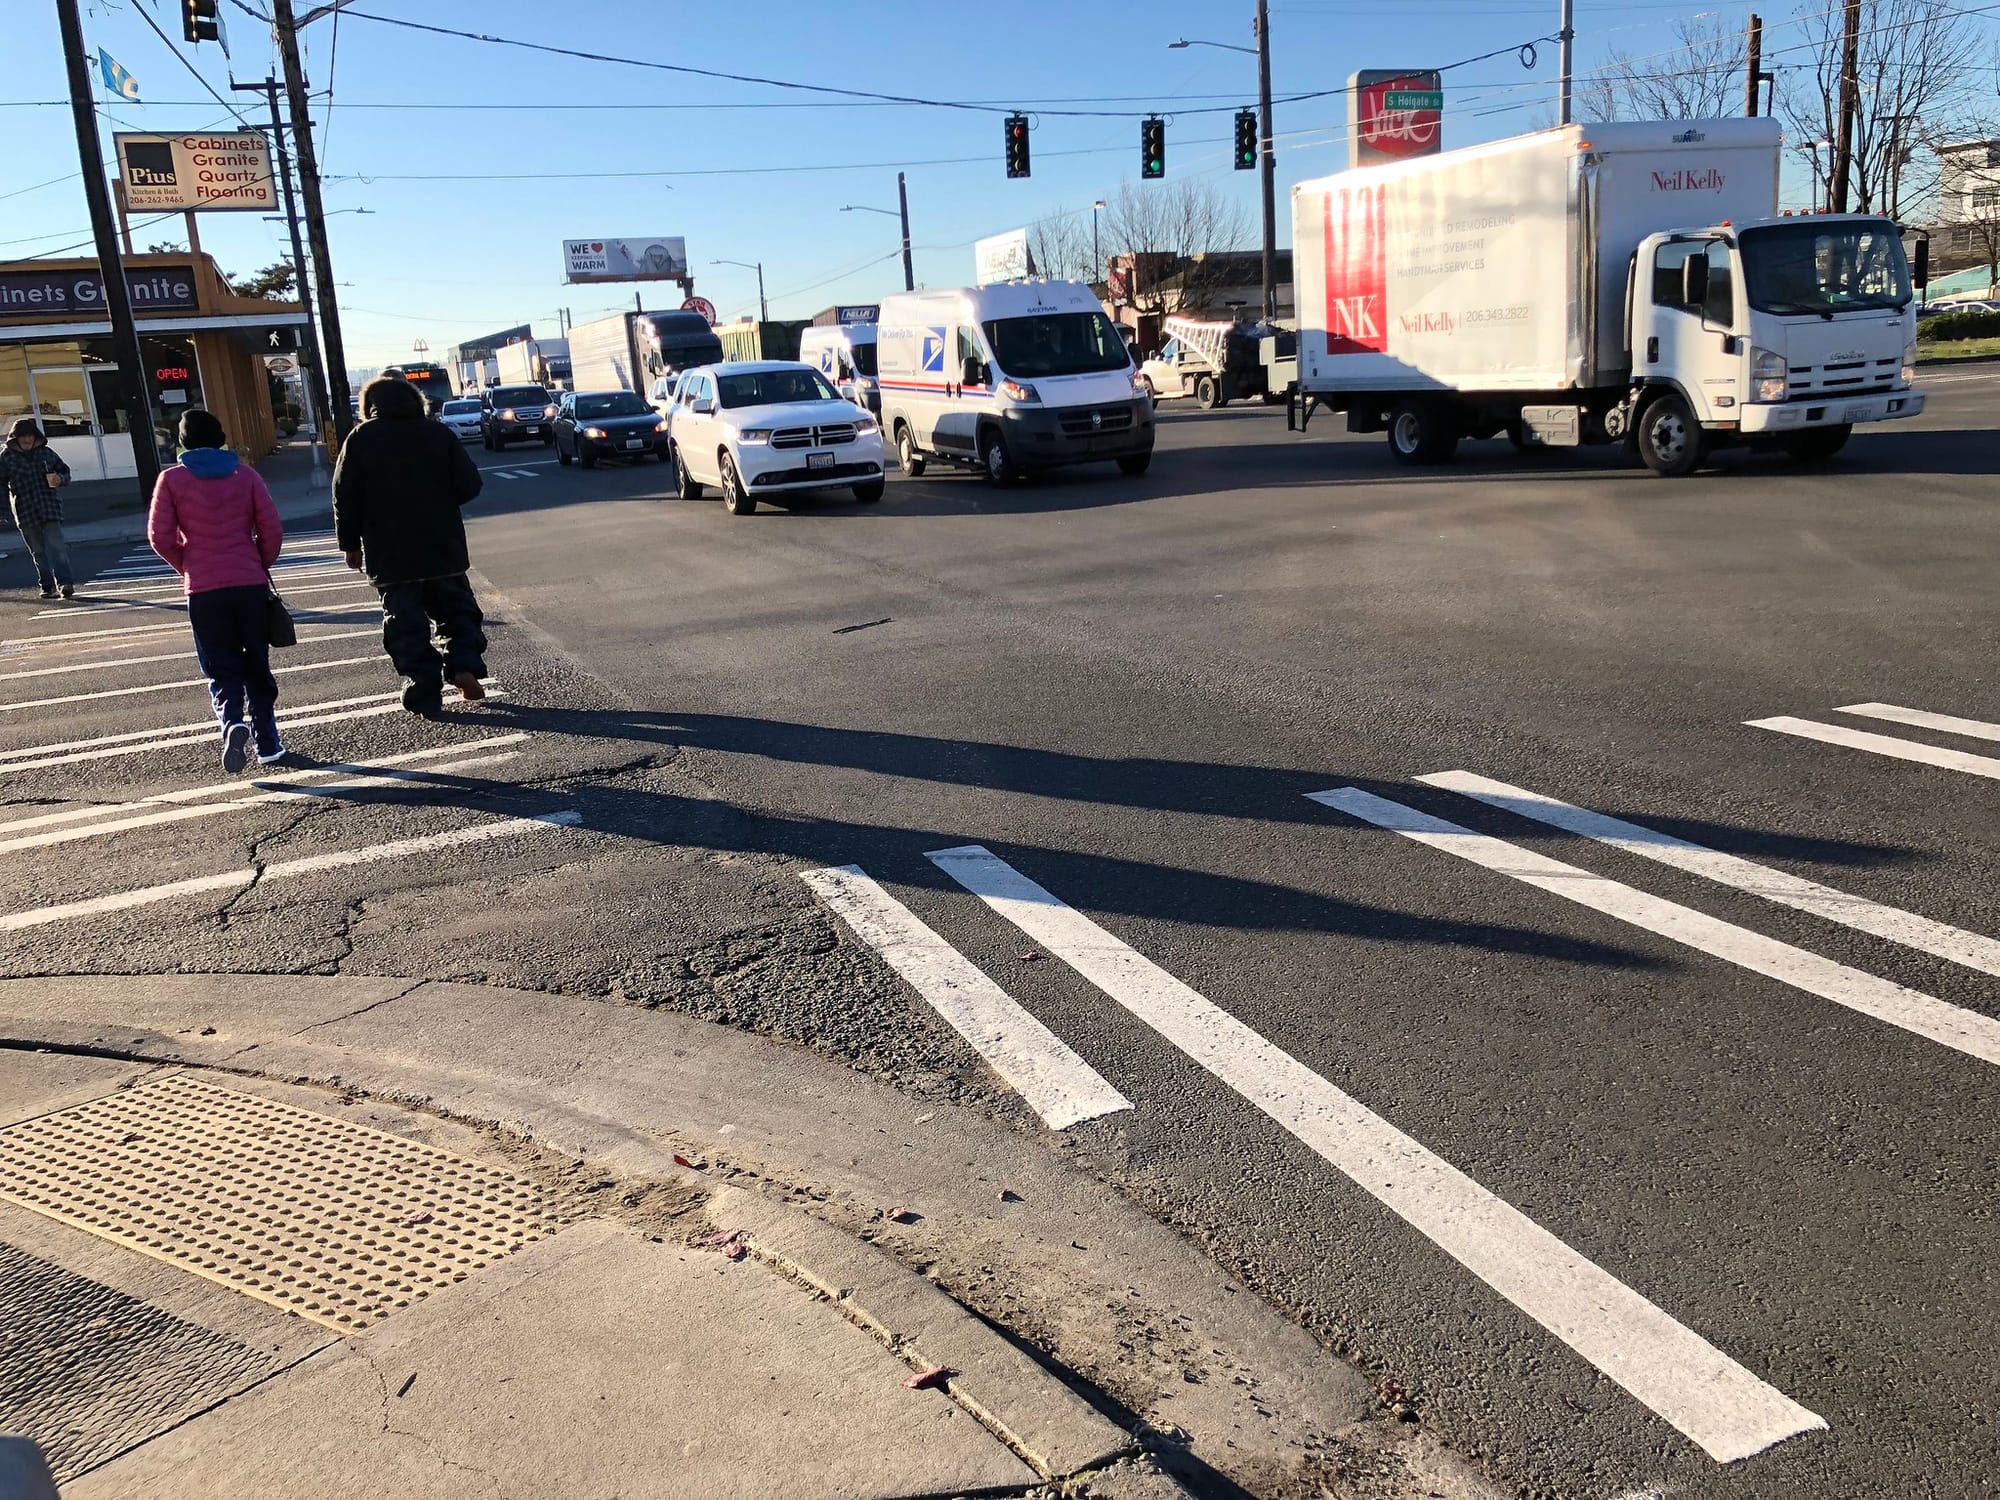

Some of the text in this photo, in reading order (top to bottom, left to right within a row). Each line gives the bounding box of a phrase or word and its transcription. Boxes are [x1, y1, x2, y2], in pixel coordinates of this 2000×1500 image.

[1388, 96, 1394, 106] S
[1398, 95, 1429, 108] Holgate
[183, 137, 264, 151] Cabinets
[192, 153, 259, 166] Granite
[130, 167, 176, 184] Pius
[198, 169, 258, 183] Quartz
[1650, 169, 1726, 194] Neil Kelly
[195, 185, 267, 200] Flooring
[130, 196, 184, 204] 206-262-9465
[570, 243, 589, 254] WE
[571, 260, 606, 270] WARM
[1444, 258, 1485, 273] SERVICES
[0, 278, 190, 303] inets Grnite
[1333, 295, 1381, 340] NK
[1399, 306, 1529, 336] Neil Kelly 206.343.2822
[156, 367, 188, 380] OPEN
